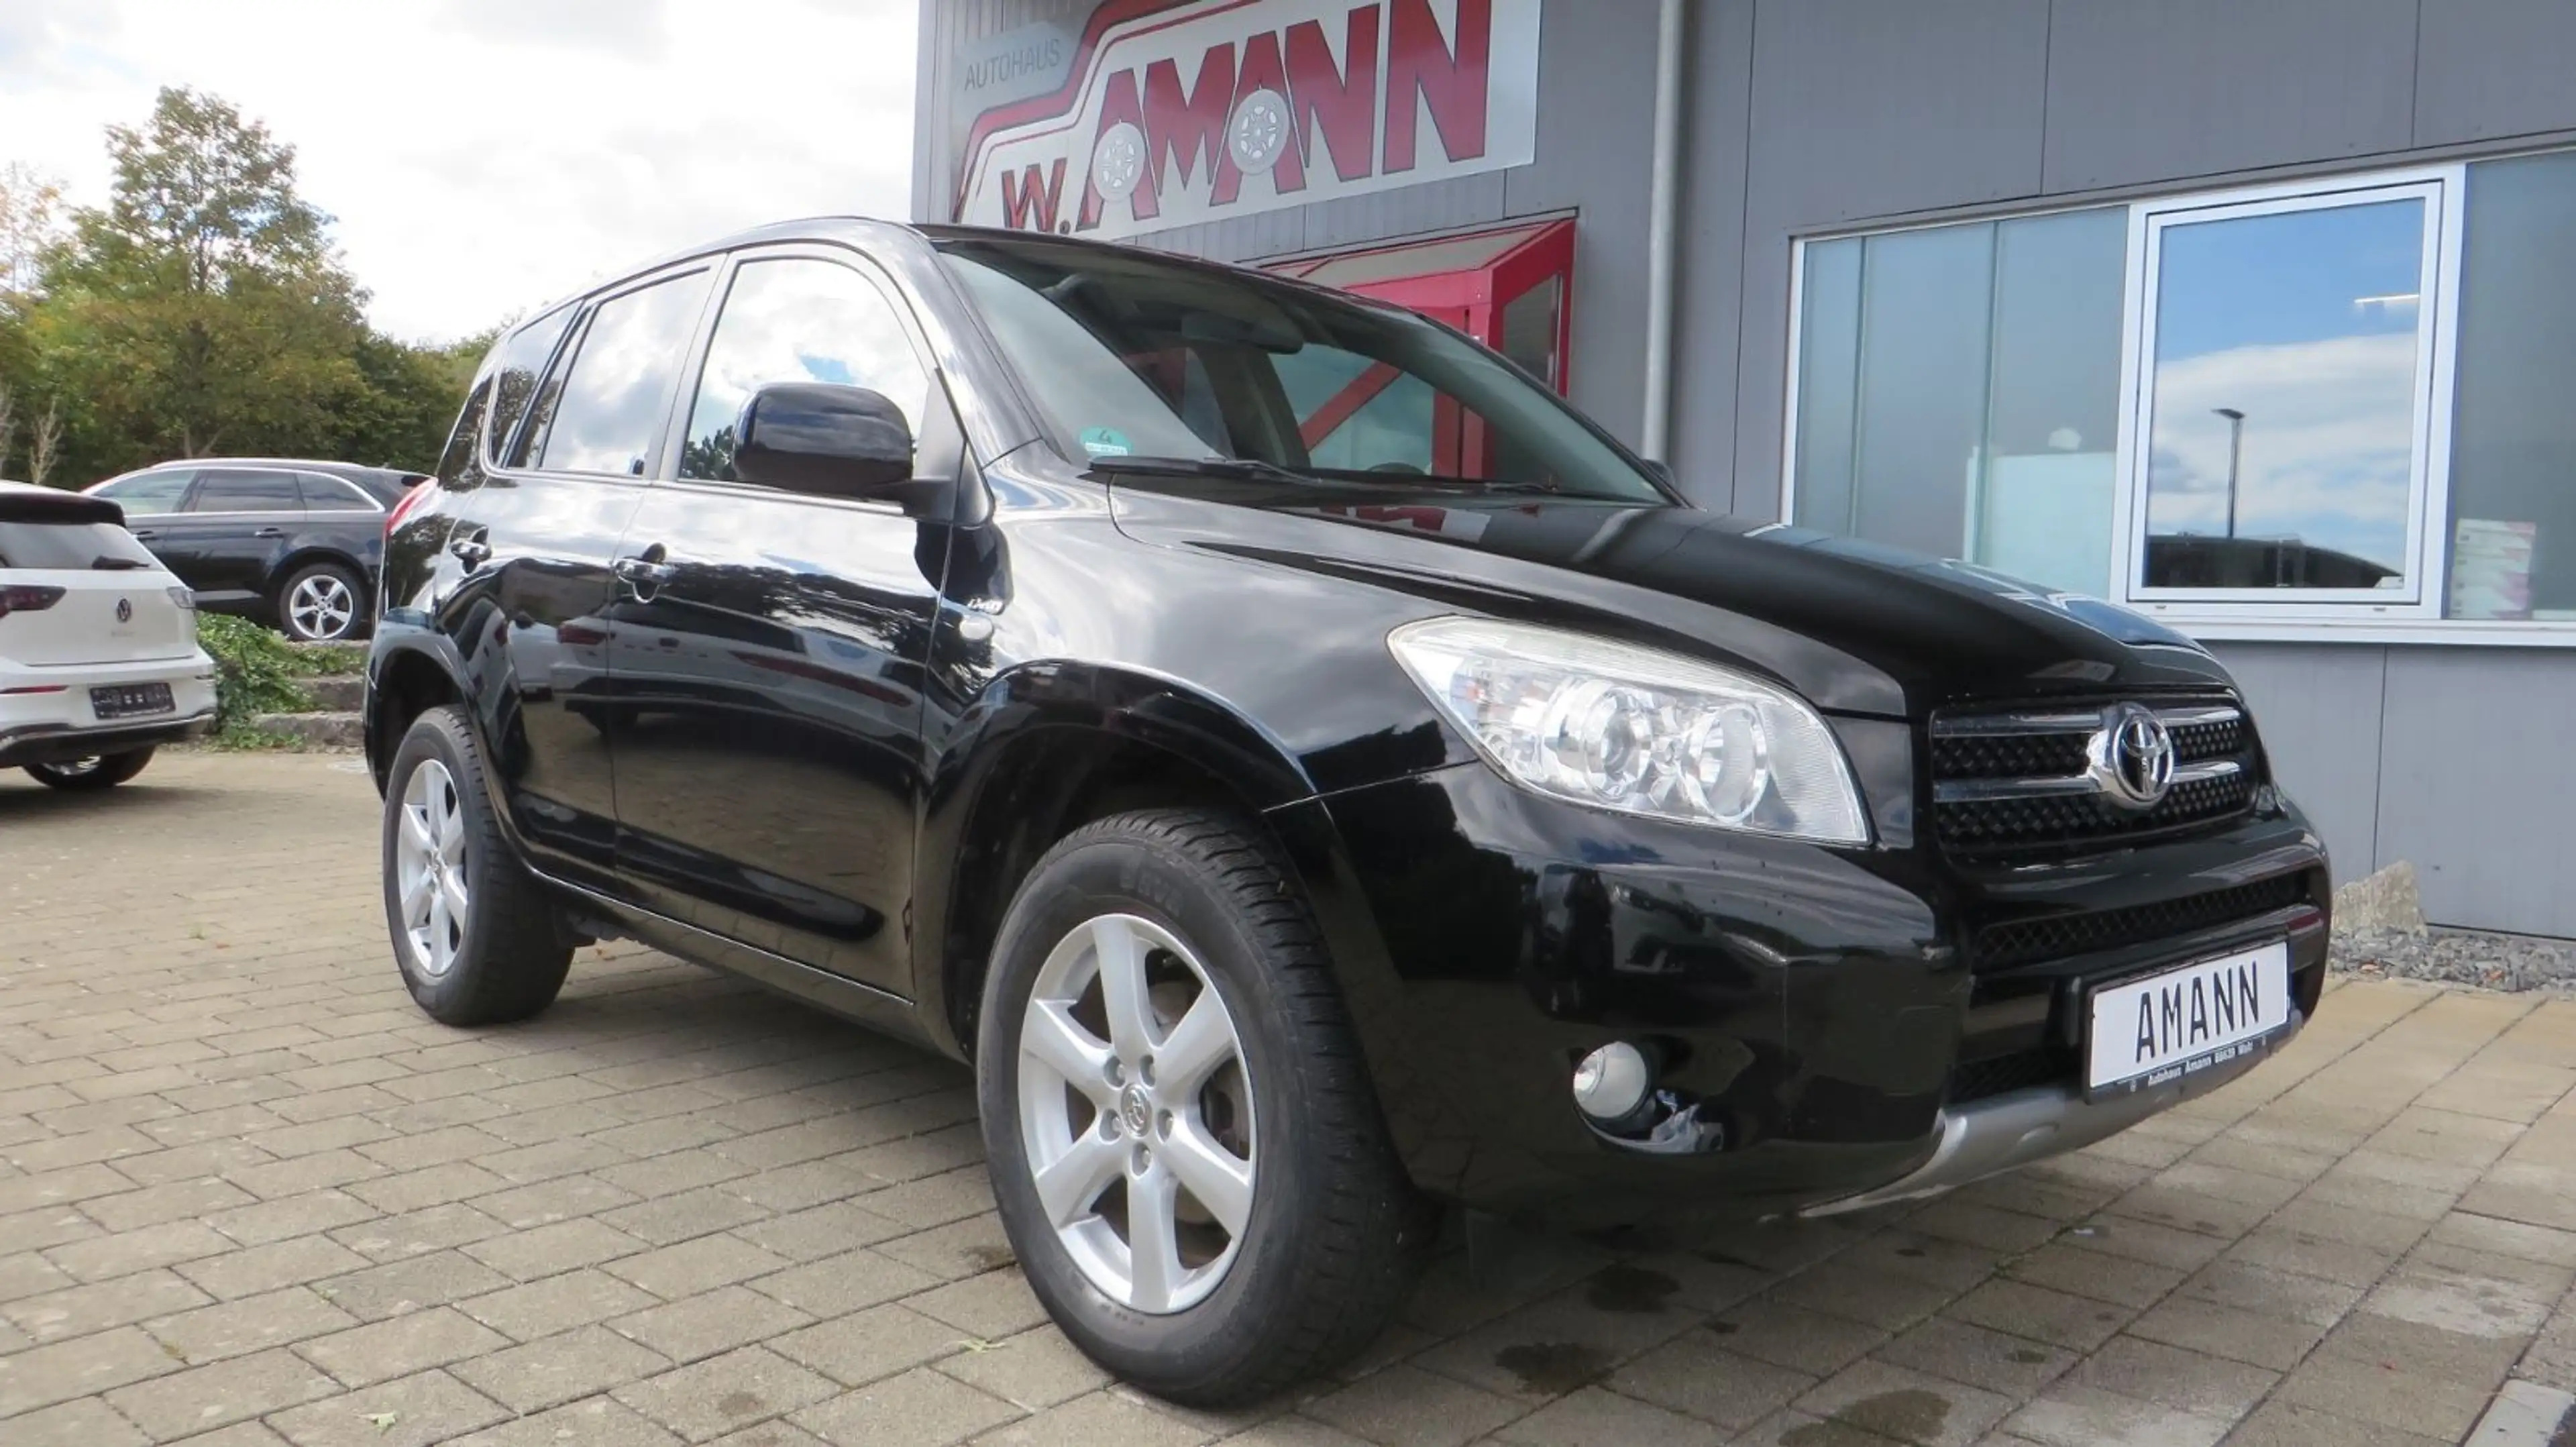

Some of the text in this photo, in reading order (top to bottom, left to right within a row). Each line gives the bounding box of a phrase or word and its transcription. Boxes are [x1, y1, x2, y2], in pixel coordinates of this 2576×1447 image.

[965, 38, 1062, 91] AUTOHAUS
[1075, 0, 1491, 232] AMANN
[2135, 960, 2259, 1063] AMANN
